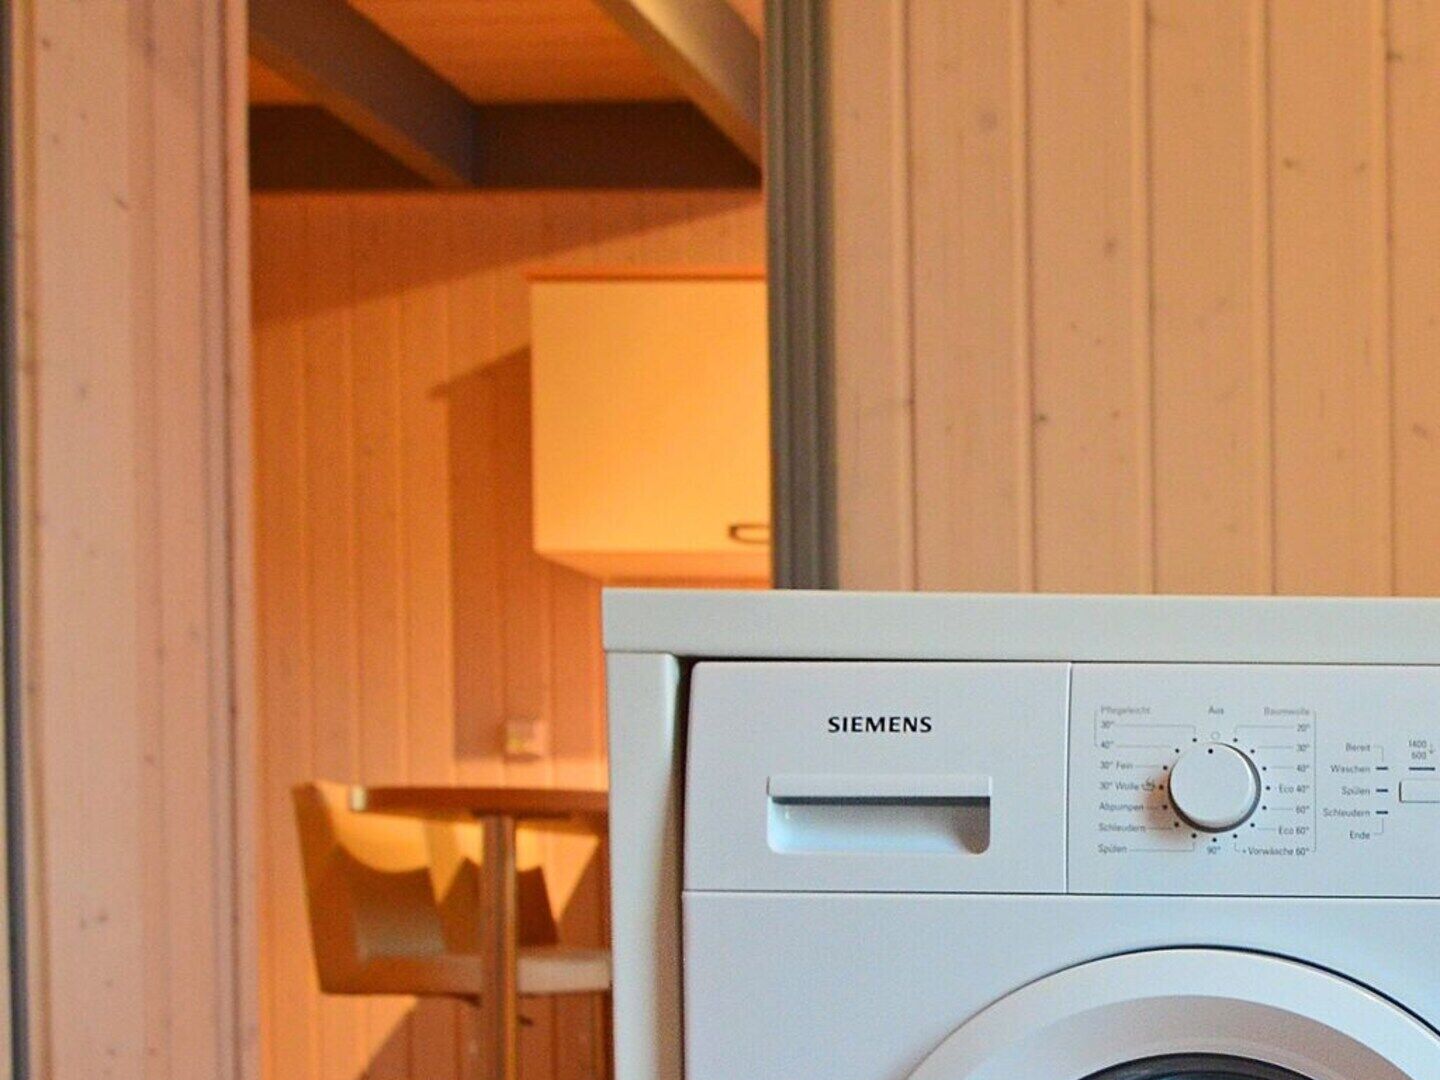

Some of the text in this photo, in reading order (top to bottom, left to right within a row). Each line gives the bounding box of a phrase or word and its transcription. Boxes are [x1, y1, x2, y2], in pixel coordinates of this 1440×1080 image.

[1208, 705, 1225, 715] Aus
[827, 716, 932, 733] SIEMENS
[1345, 743, 1371, 752] Bereit
[1116, 760, 1134, 769] Fein
[1330, 764, 1371, 774] Waschen
[1115, 781, 1140, 790] Wolle
[1278, 784, 1294, 794] Eco
[1098, 801, 1144, 811] Abpumpen
[1322, 808, 1371, 818] Schleudern
[1098, 822, 1146, 832] Schleudern
[1278, 825, 1294, 835] Eco
[1349, 830, 1371, 840] Ende
